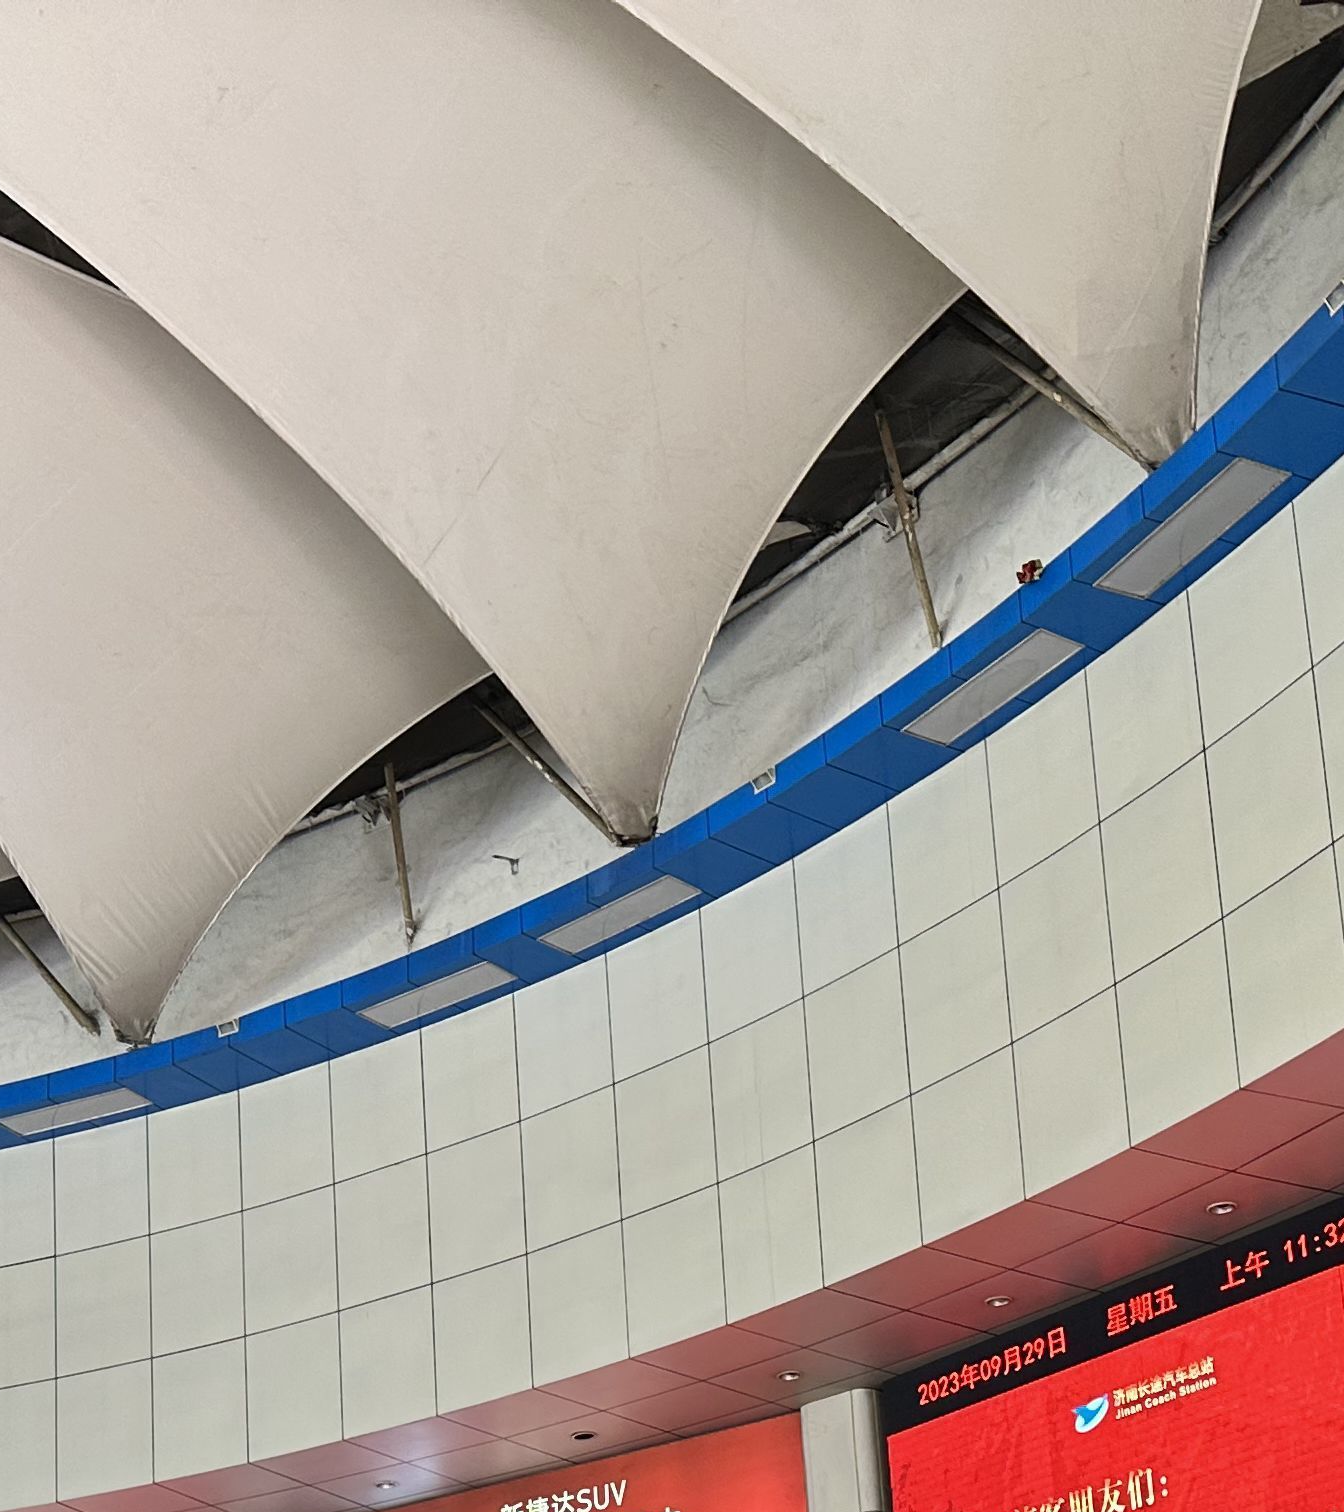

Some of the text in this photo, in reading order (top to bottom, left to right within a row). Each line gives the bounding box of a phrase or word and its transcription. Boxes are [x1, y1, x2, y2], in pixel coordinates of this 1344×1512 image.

[917, 1326, 1067, 1405] 2023年09月29日
[1106, 1286, 1177, 1338] 星期五
[1219, 1249, 1270, 1292] 上午
[1113, 1355, 1215, 1407] 济南长途汽车总站
[1116, 1376, 1217, 1420] Jinan Coach Station
